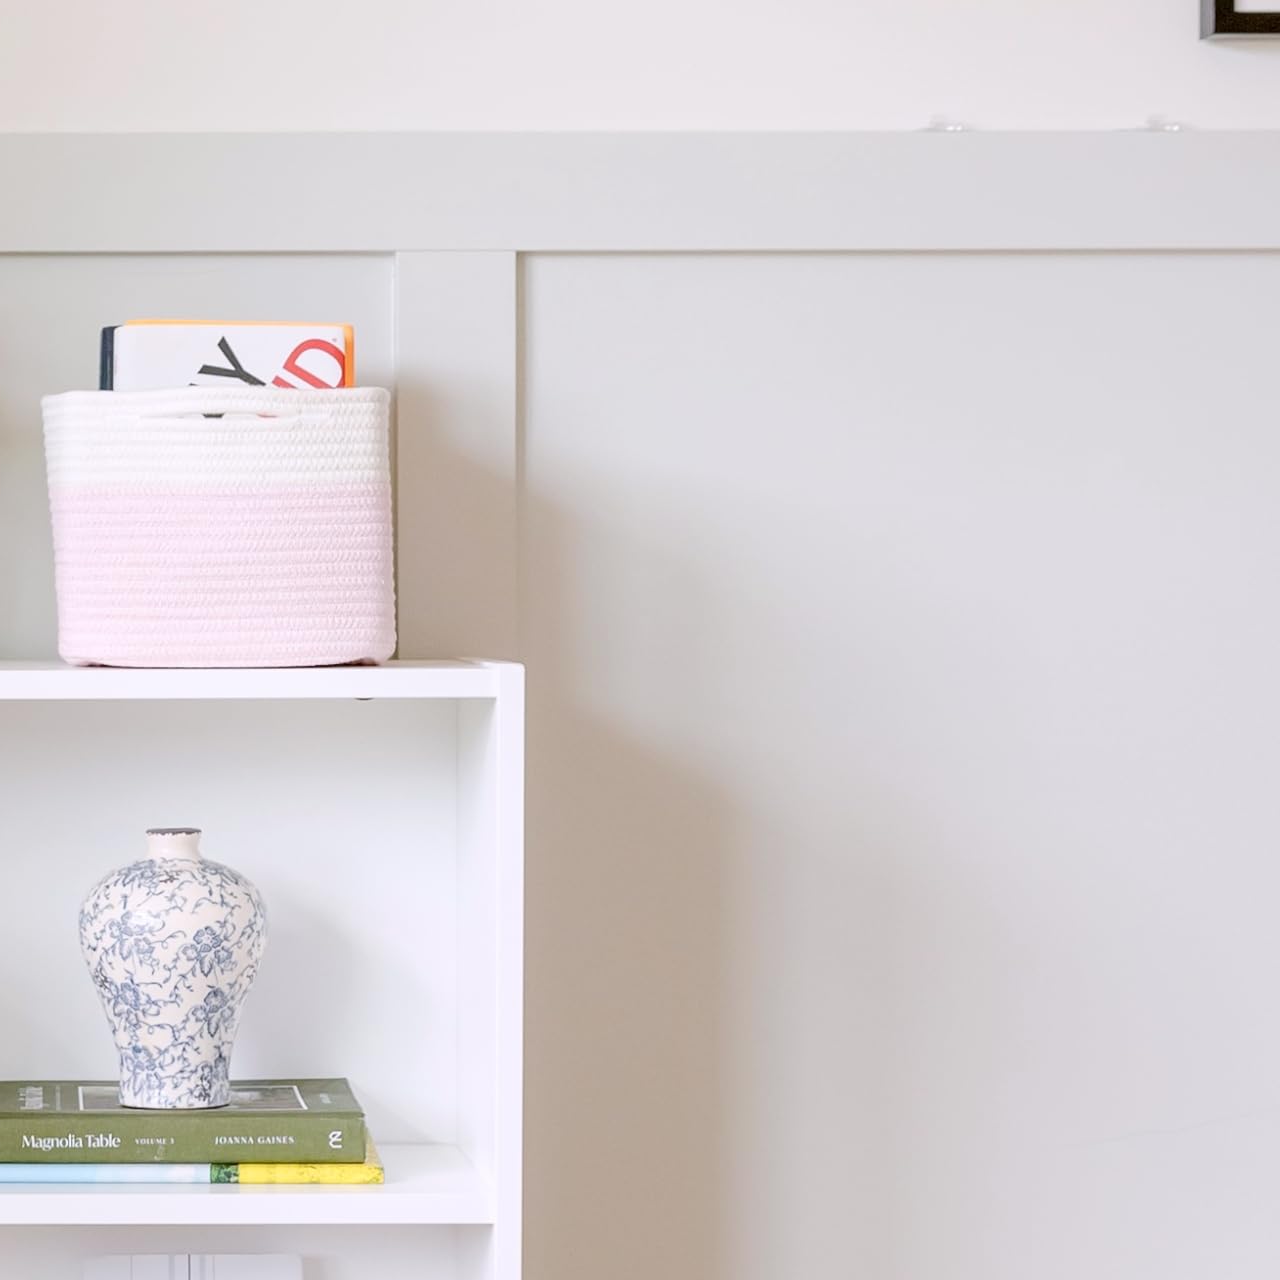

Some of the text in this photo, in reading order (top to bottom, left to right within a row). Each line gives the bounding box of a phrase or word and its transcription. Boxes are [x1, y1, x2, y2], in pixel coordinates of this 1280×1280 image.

[21, 1132, 84, 1151] Magnolia
[85, 1133, 122, 1149] Table
[134, 1137, 167, 1145] VOLUME
[214, 1135, 296, 1145] JOANNA GAINES
